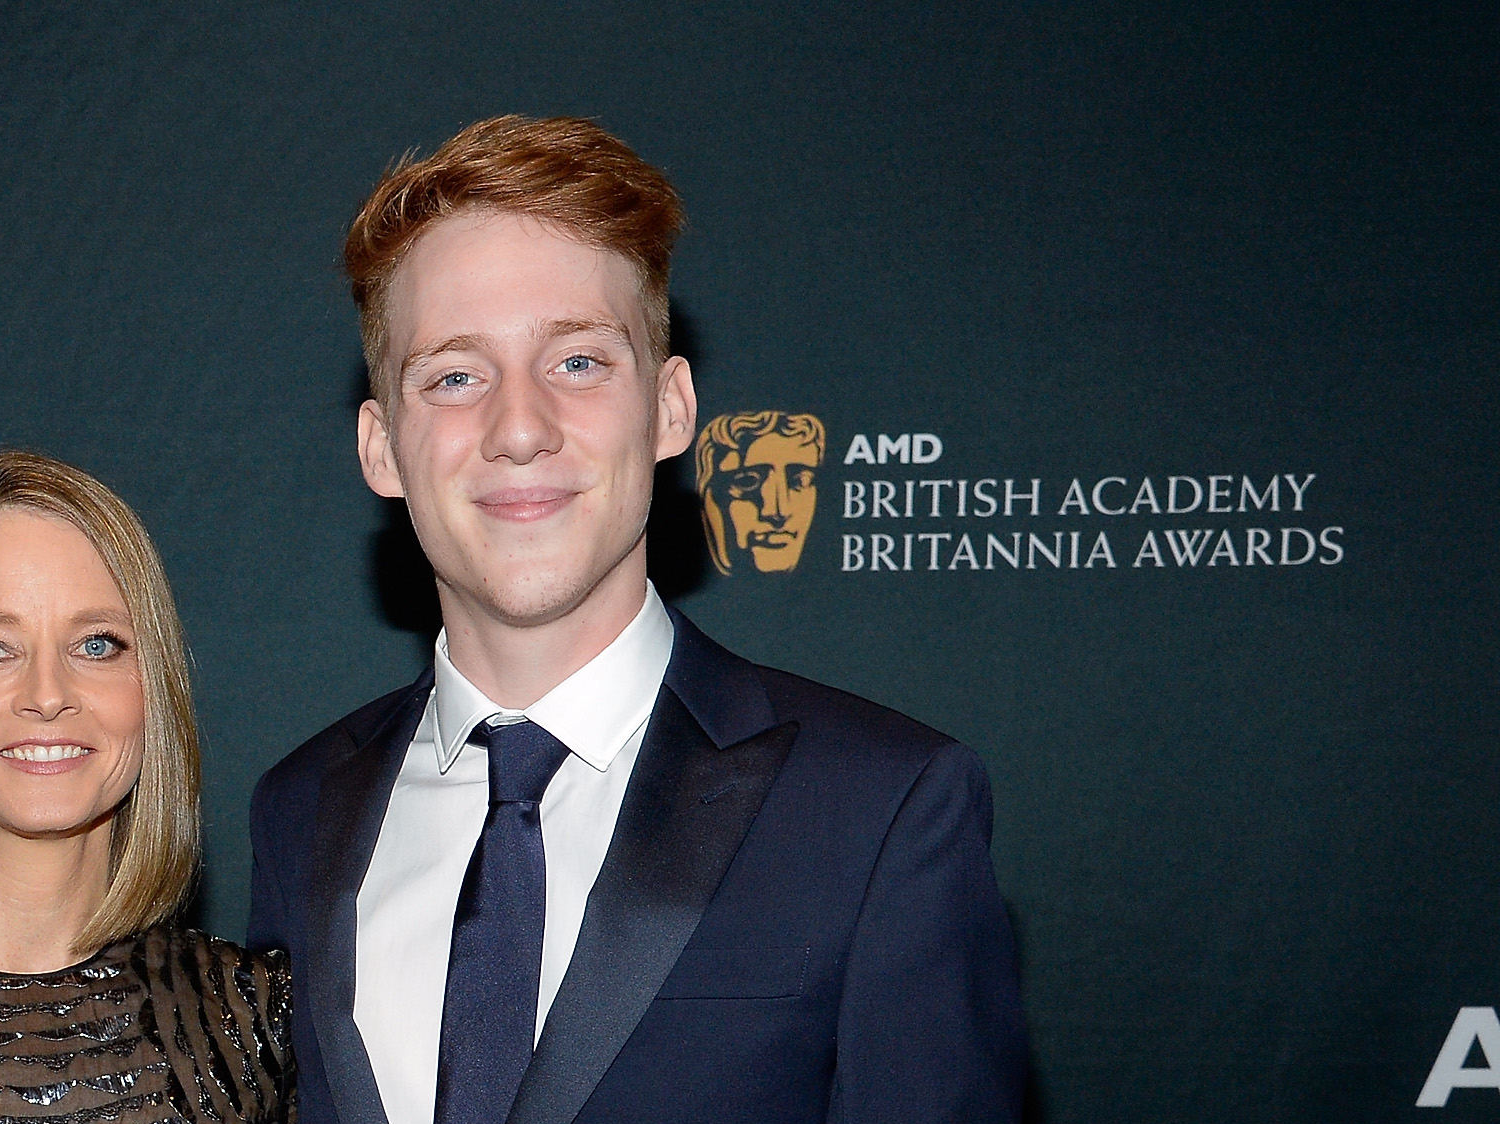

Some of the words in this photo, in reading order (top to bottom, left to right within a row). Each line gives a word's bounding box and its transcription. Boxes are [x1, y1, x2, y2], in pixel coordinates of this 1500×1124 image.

[843, 433, 943, 465] AMD
[843, 478, 1041, 519] BRITISH
[1057, 474, 1316, 516] ACADEMY
[842, 530, 1117, 572] BRITANNIA
[1133, 526, 1344, 568] AWARDS
